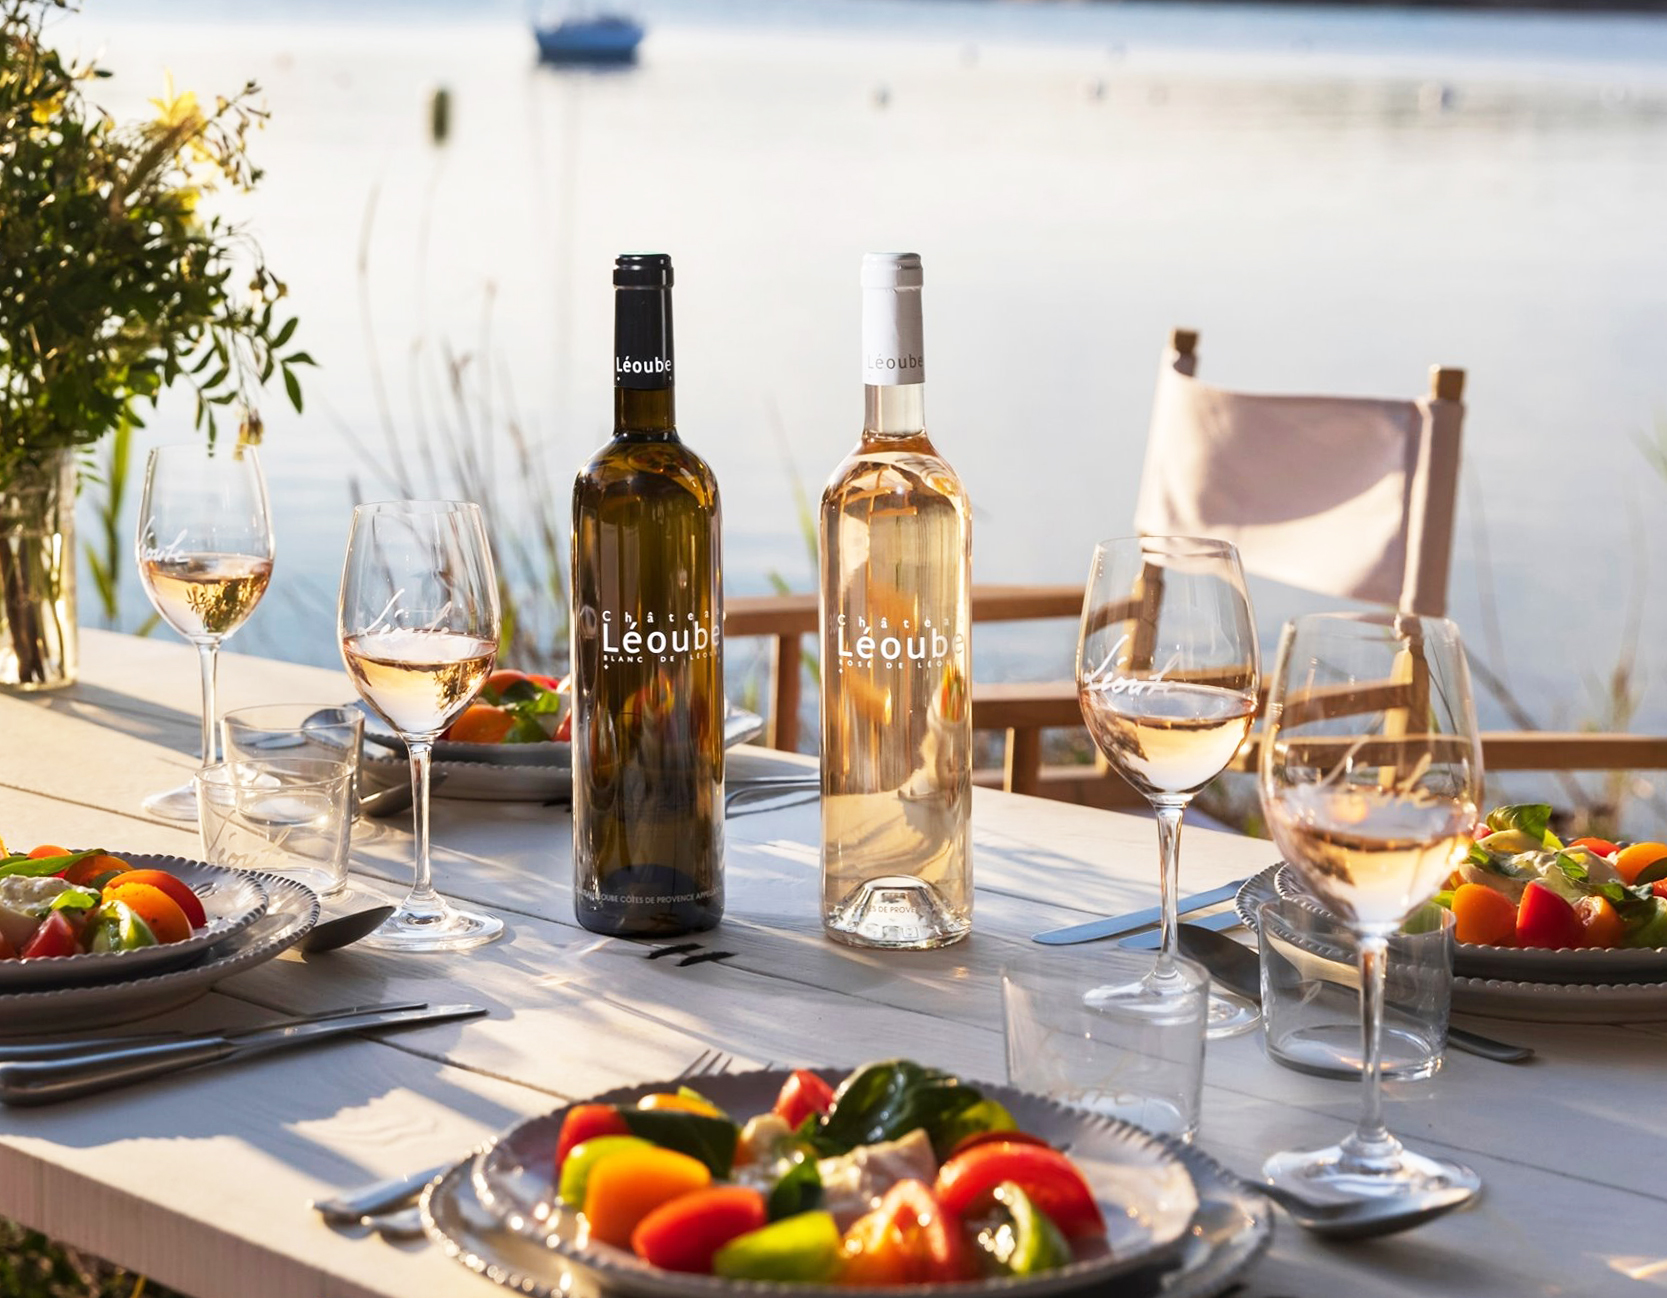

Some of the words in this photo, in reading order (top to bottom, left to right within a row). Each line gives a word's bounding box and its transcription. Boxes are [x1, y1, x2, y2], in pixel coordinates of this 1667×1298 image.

[616, 355, 672, 374] Léoube
[867, 353, 924, 370] Léoube
[602, 610, 719, 624] Châtea
[837, 614, 951, 629] Châtea
[602, 621, 721, 654] Léoube
[837, 626, 964, 660] Léoube
[603, 654, 643, 663] BLANC
[660, 655, 675, 663] DE
[689, 650, 714, 661] LÉO
[886, 661, 903, 670] DE
[917, 659, 943, 669] LÉO
[619, 894, 644, 904] CÔTES
[645, 895, 656, 904] DE
[656, 893, 695, 904] PROVENCE
[878, 905, 888, 913] DE
[890, 905, 917, 914] PROVE
